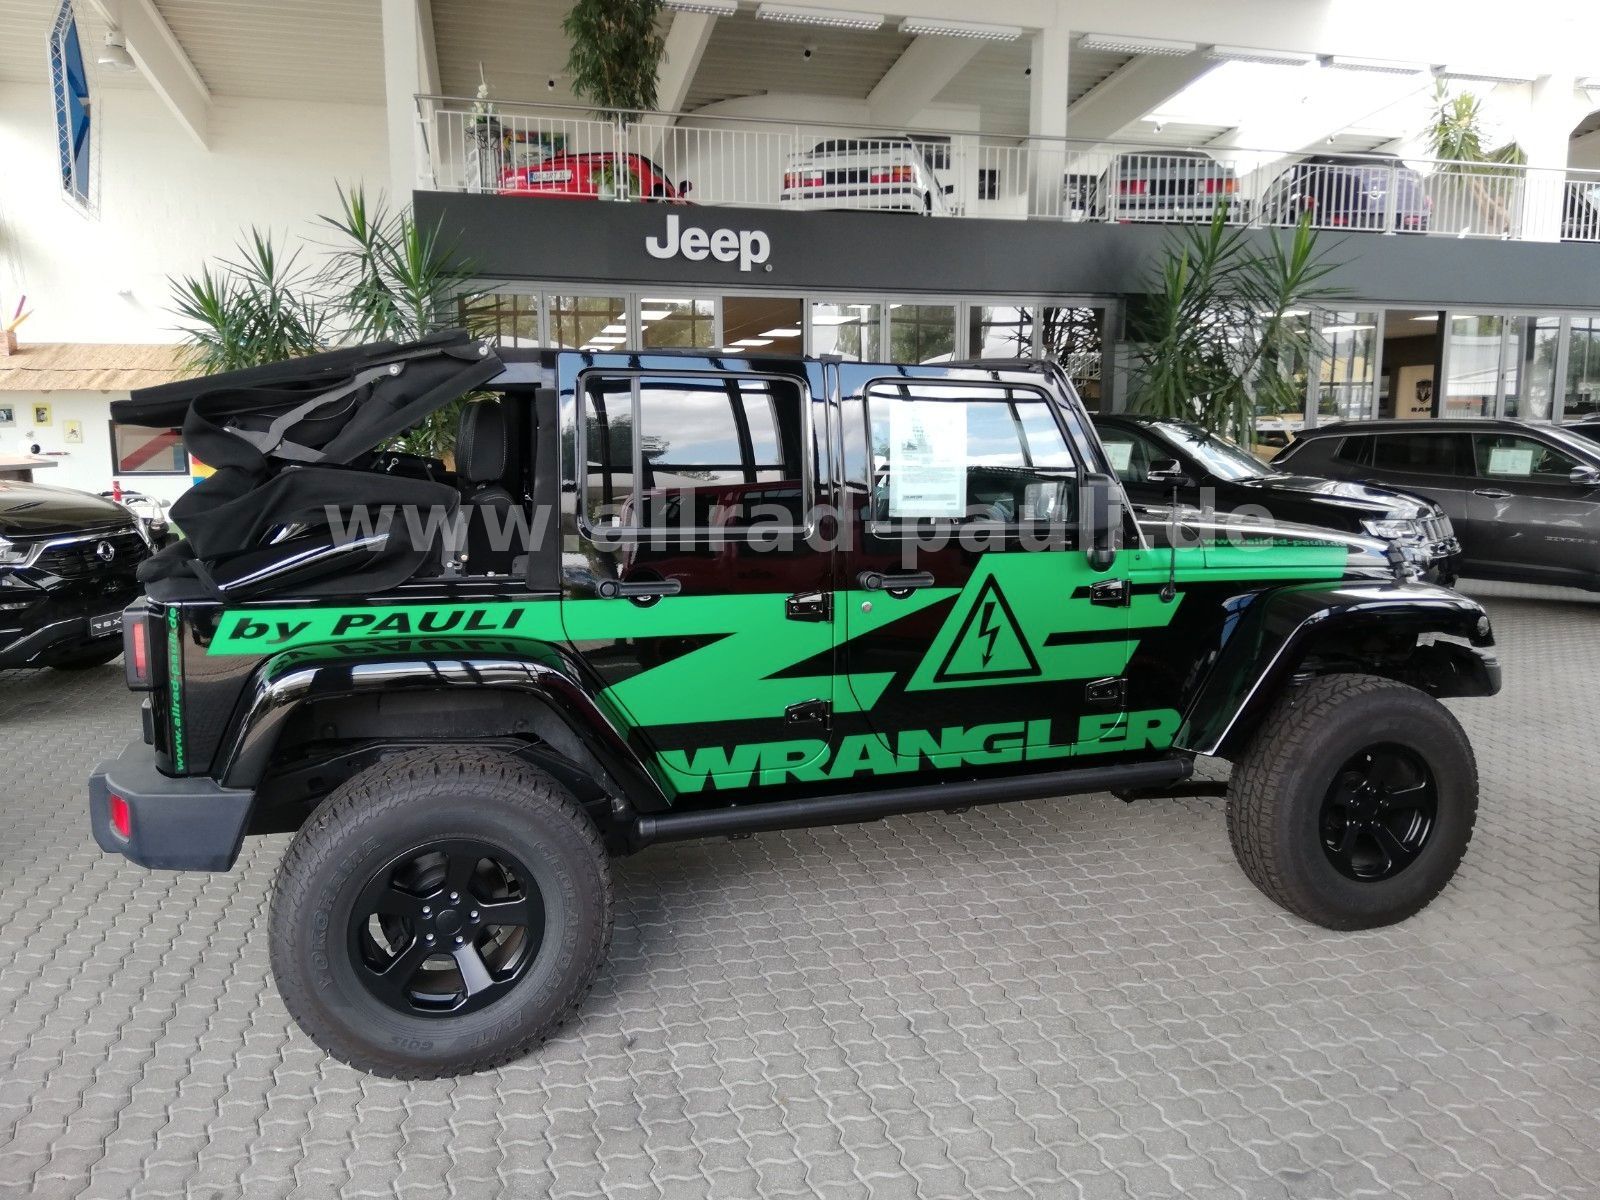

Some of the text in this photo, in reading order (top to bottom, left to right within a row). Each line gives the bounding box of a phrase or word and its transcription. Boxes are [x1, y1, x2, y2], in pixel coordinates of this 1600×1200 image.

[645, 214, 771, 272] Jeep
[229, 608, 525, 645] by PAULI
[168, 607, 184, 771] www.allrad-pauli.de
[655, 708, 1183, 793] WRANGLER
